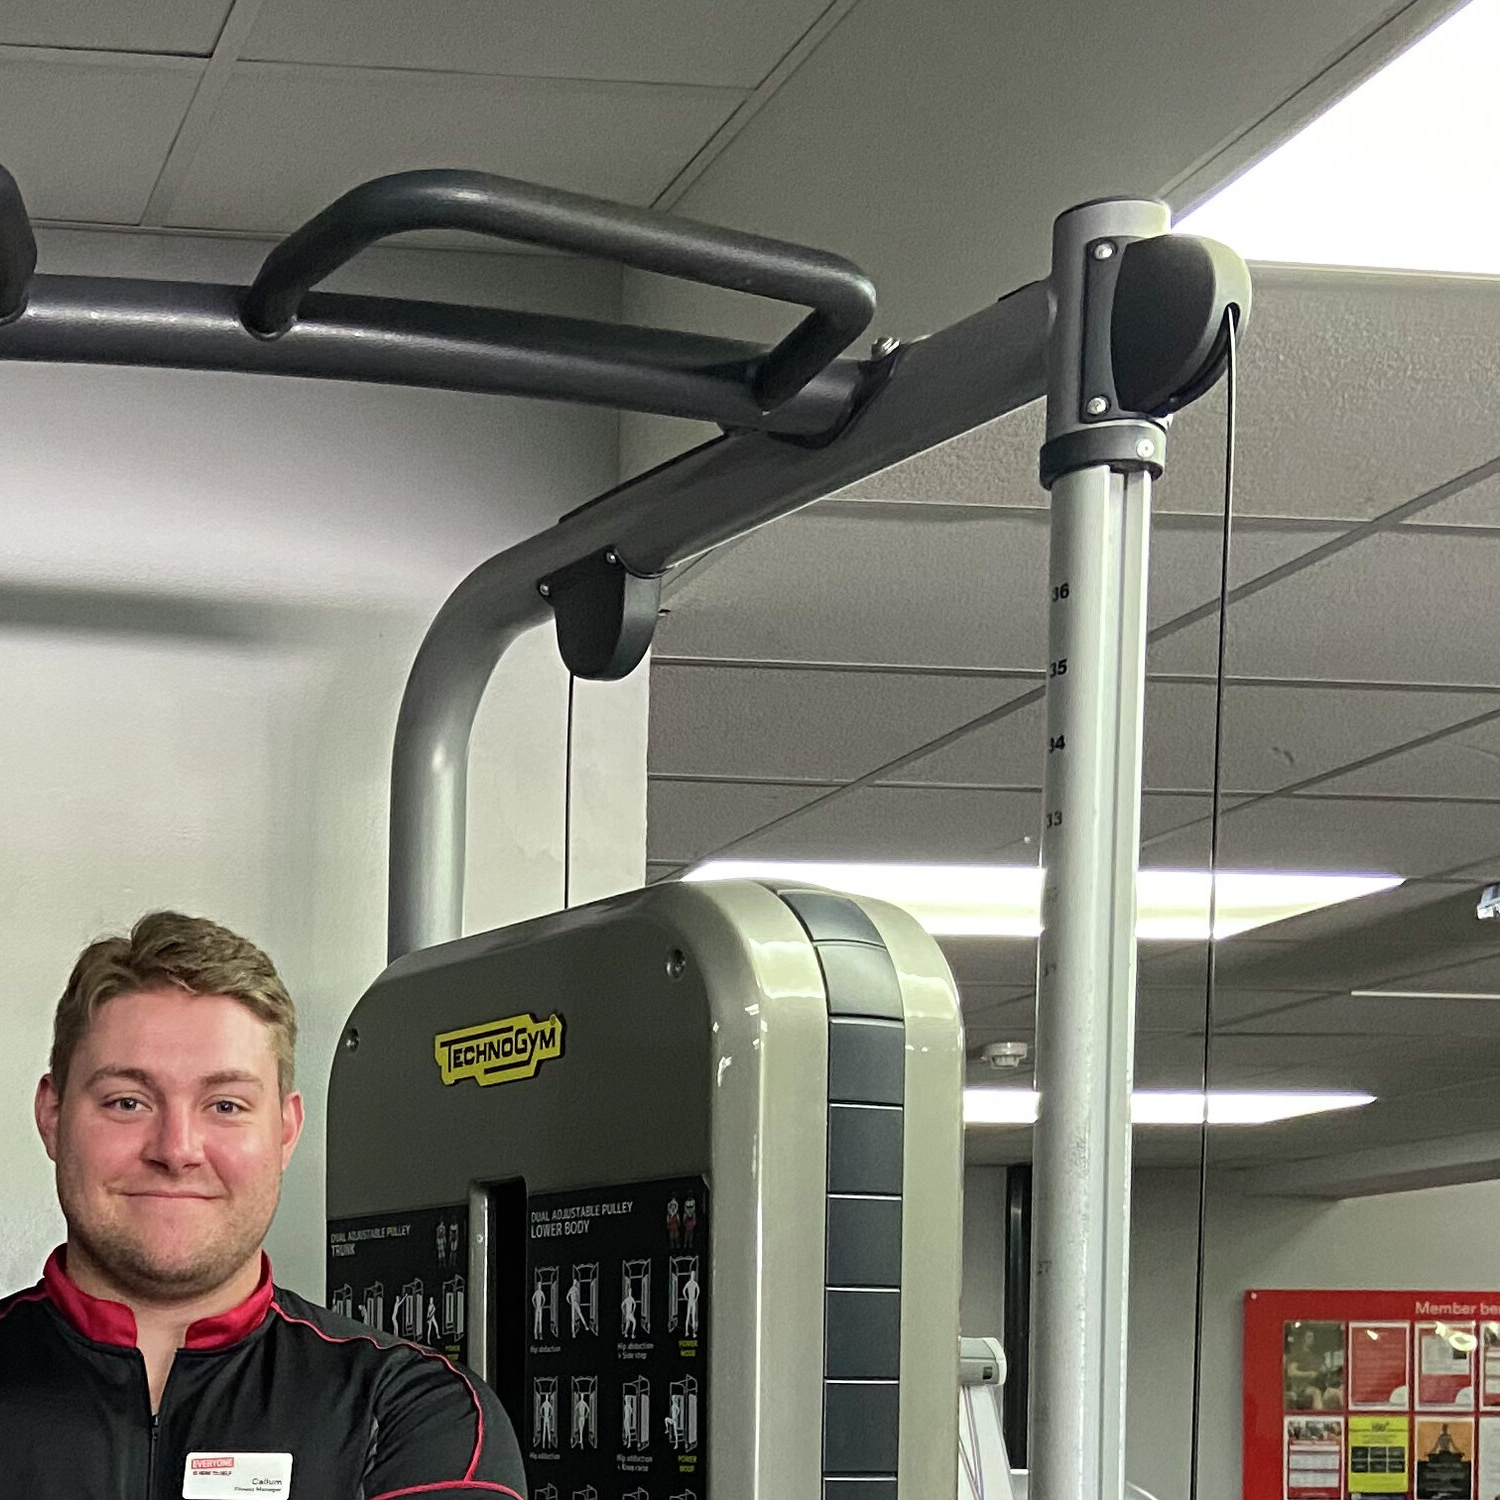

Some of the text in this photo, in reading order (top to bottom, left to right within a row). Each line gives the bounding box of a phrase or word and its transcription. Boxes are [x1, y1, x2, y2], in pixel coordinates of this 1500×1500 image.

[1052, 583, 1070, 601] 36
[1050, 658, 1068, 677] 35
[1046, 811, 1063, 829] 33
[440, 1025, 556, 1075] TECHNOGYM
[531, 1201, 633, 1223] DUAL ADJUSTABLE PULLEY
[330, 1233, 347, 1243] DUAL
[386, 1225, 411, 1237] PULLEY
[531, 1220, 590, 1239] LOWER BODY
[1415, 1301, 1477, 1315] Member
[191, 1458, 234, 1469] EVERYONE
